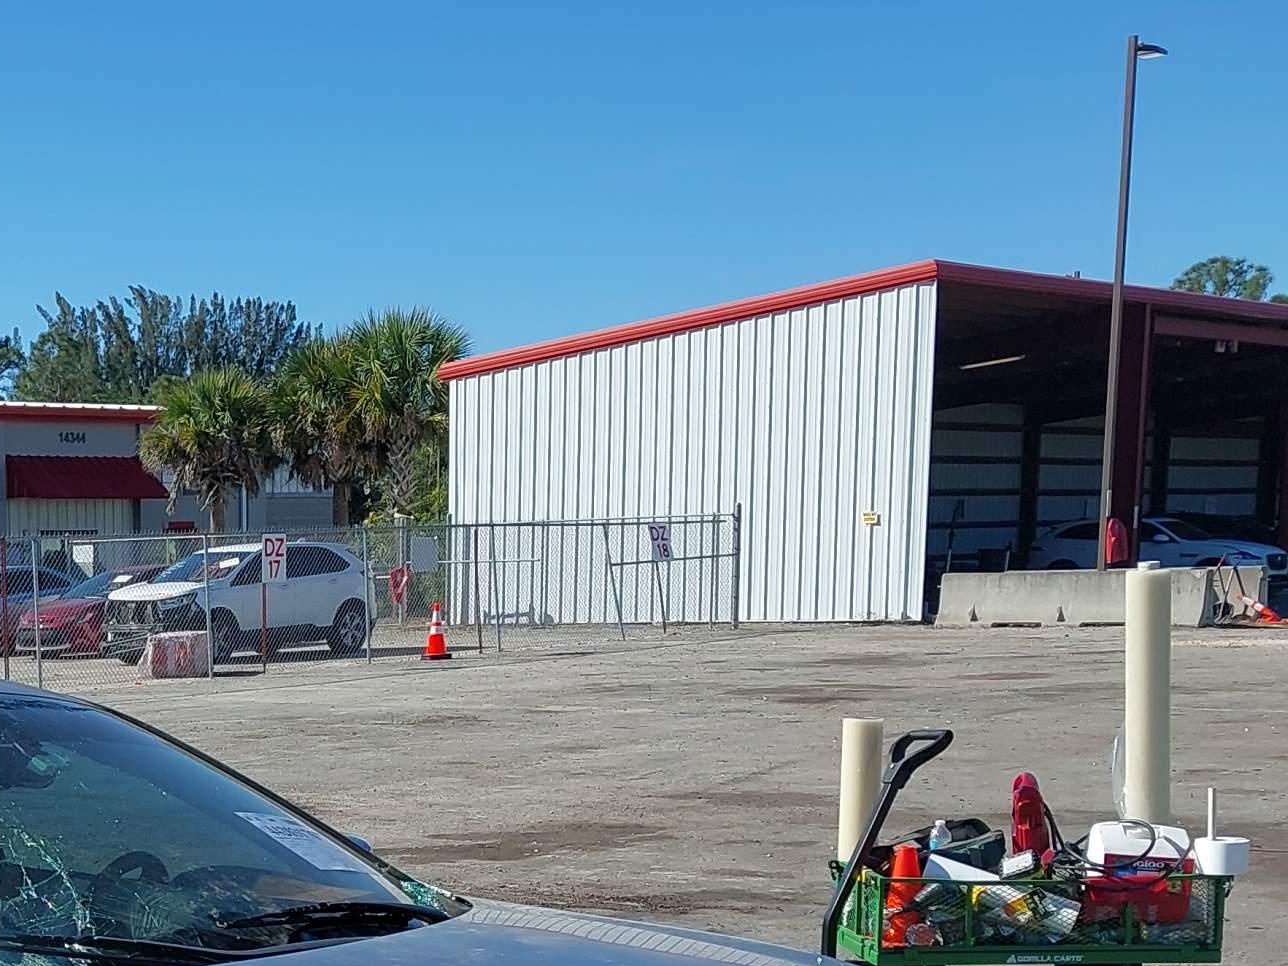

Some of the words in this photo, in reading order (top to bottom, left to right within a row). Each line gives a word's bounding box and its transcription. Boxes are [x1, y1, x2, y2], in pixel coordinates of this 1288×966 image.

[59, 432, 86, 444] 14344
[650, 526, 668, 541] DZ
[264, 538, 284, 557] DZ
[657, 543, 669, 558] 18
[269, 560, 280, 578] 17
